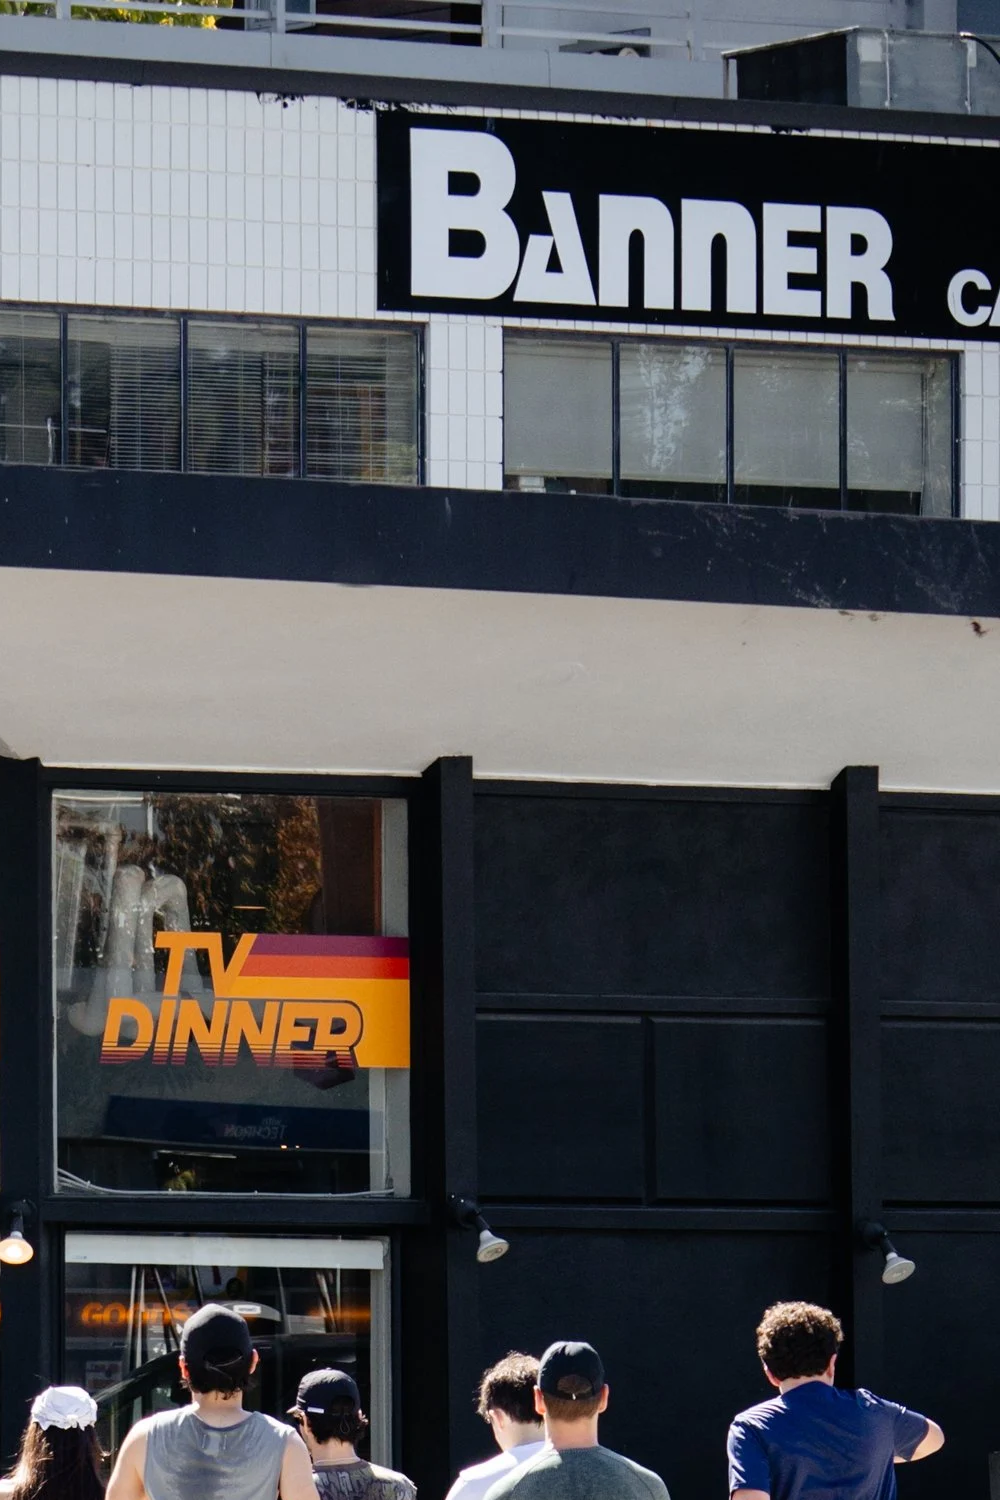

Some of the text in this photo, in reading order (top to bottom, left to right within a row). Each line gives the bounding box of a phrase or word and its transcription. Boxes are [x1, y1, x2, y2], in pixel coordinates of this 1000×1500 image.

[947, 268, 1000, 328] C
[154, 931, 257, 997] TV
[101, 997, 360, 1067] DINNER
